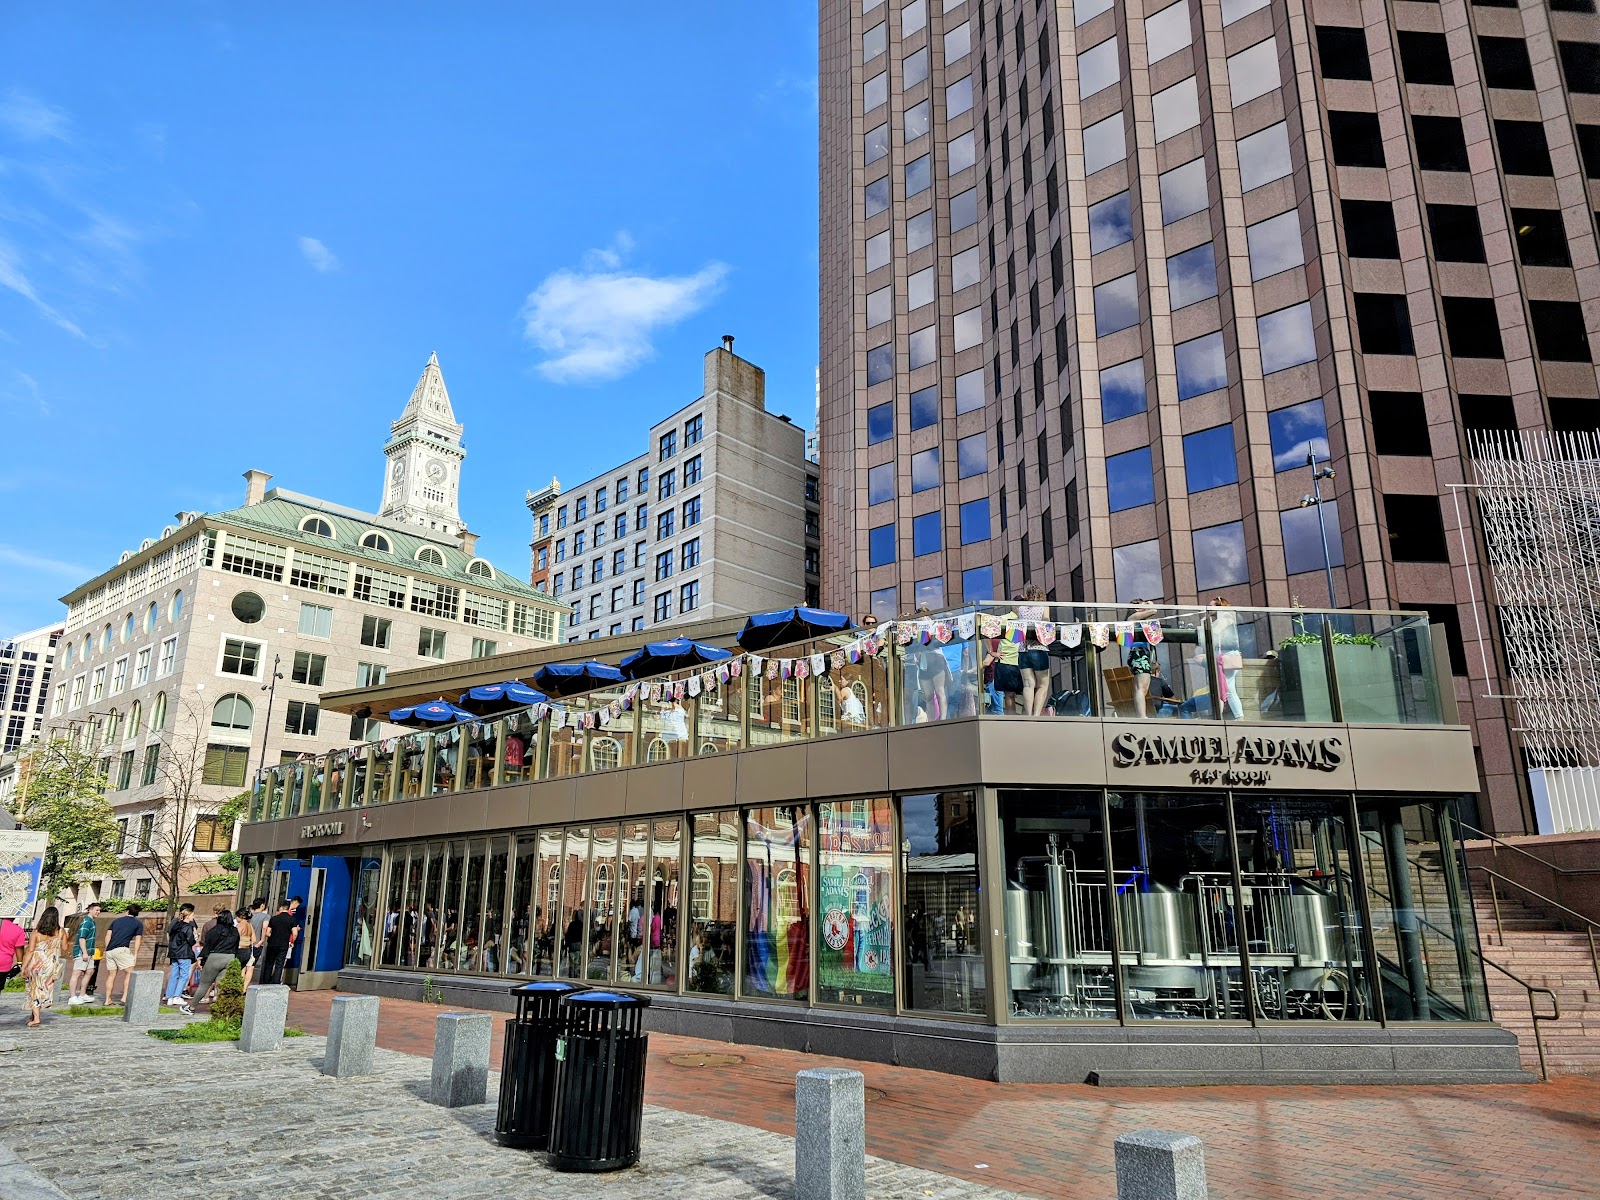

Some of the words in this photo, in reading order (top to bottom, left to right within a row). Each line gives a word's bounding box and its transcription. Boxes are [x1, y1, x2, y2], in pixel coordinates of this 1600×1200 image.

[1113, 732, 1235, 767] SAMUEL
[1236, 736, 1345, 771] ADAMS
[1192, 769, 1223, 783] TAP
[1226, 769, 1272, 784] ROOM
[823, 876, 852, 888] SAMUEL
[825, 886, 850, 898] ADAMS
